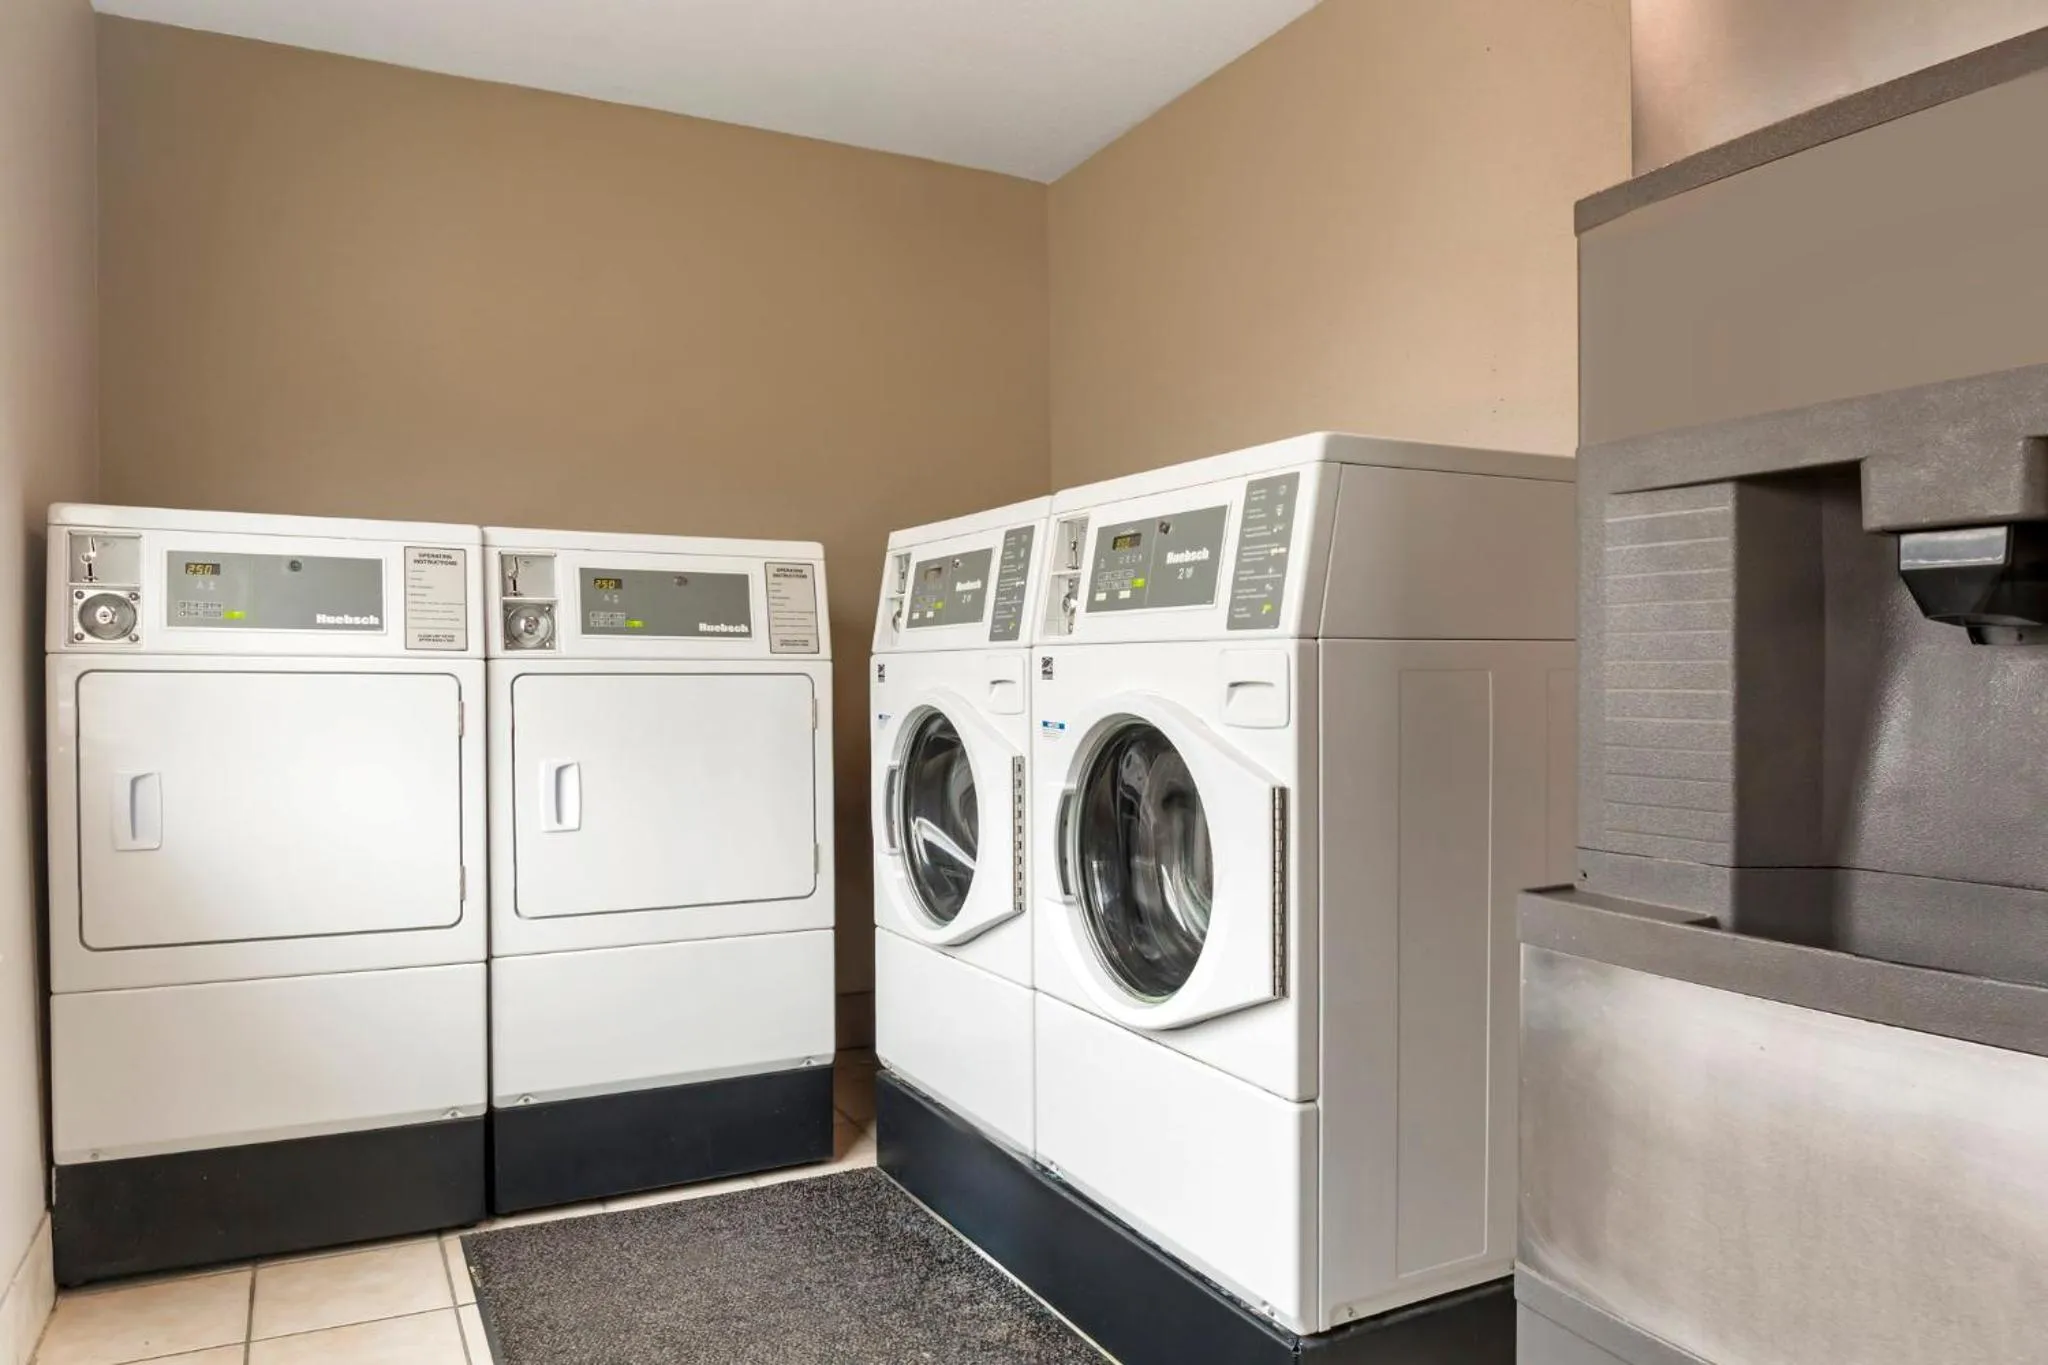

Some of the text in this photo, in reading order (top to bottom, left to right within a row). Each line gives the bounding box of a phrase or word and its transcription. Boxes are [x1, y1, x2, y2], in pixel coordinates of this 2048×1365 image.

[187, 563, 213, 575] 250
[316, 613, 380, 625] Huebsch
[698, 622, 749, 633] Huebsch
